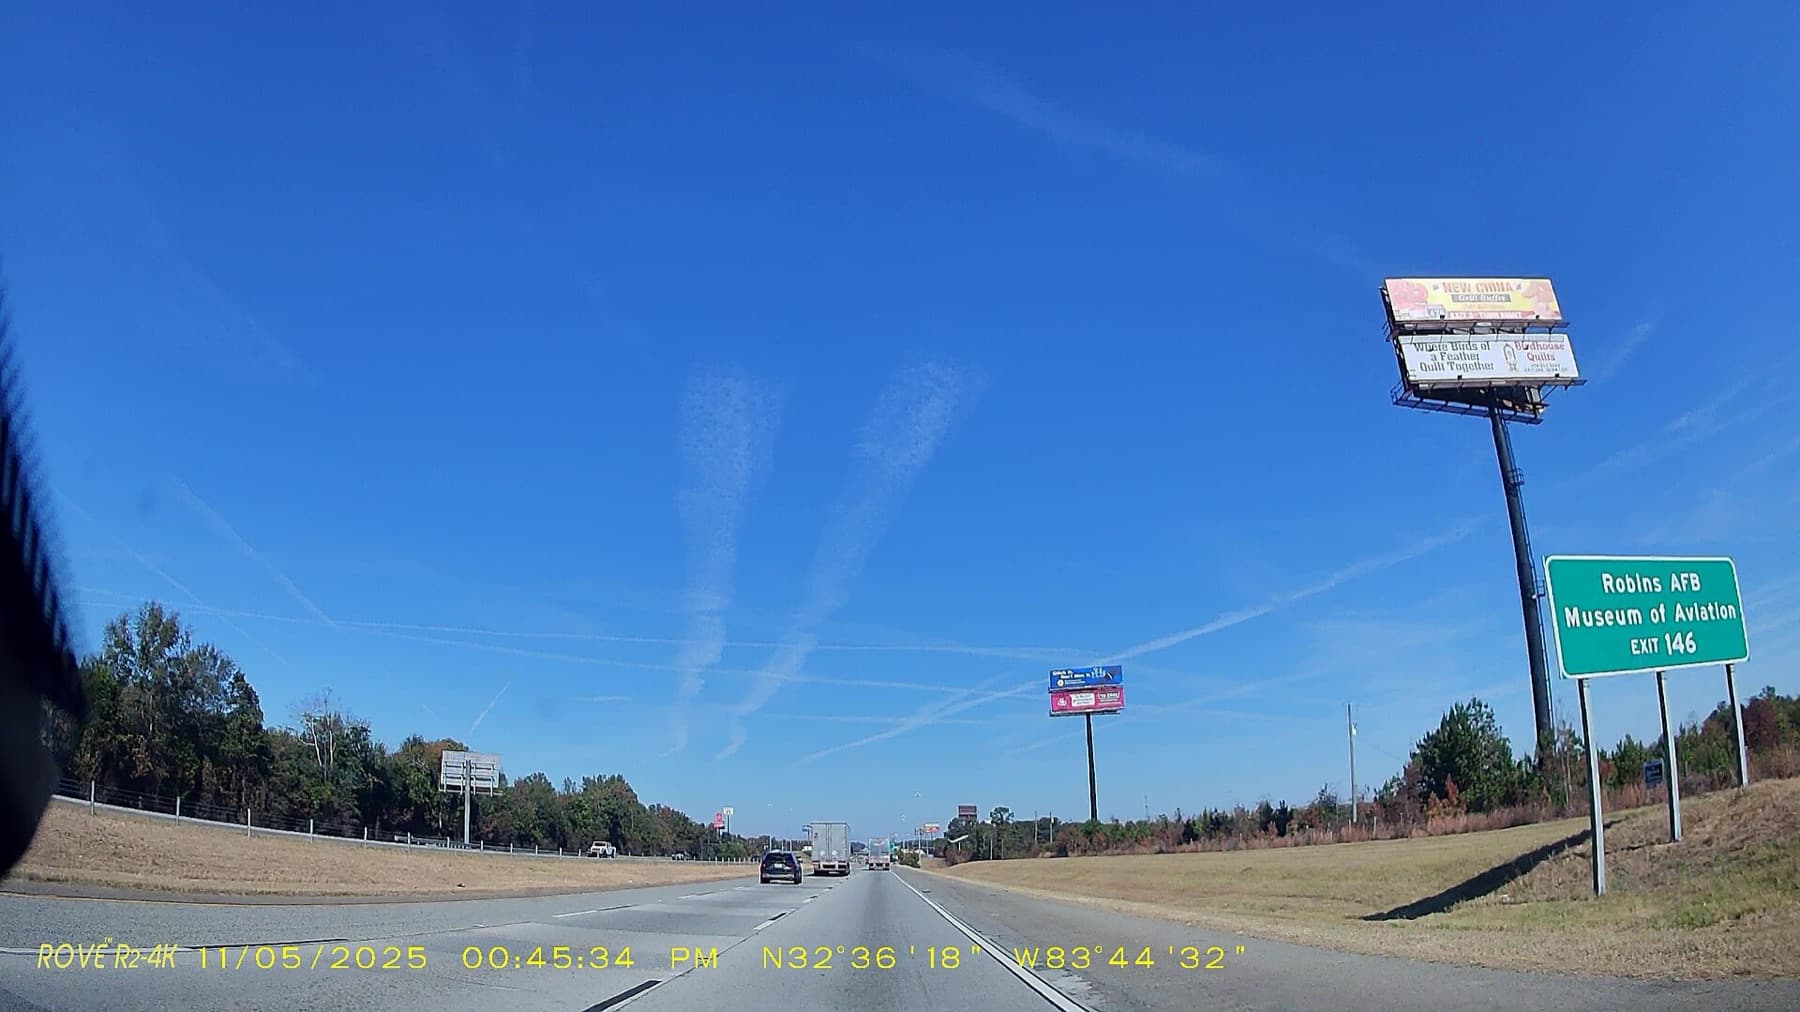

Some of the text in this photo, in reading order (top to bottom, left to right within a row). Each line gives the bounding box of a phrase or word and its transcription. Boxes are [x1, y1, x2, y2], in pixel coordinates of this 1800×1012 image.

[1442, 282, 1512, 293] NEW CHINA
[1450, 343, 1478, 351] Birds
[1481, 342, 1491, 350] of
[1515, 341, 1565, 350] Bdhouse
[1440, 352, 1480, 361] Feather
[1527, 352, 1555, 361] Quilts
[1420, 361, 1494, 372] Quilt Together
[1602, 573, 1701, 593] Robins AFB
[1564, 602, 1736, 628] Museum of Aviation
[1631, 632, 1697, 655] EXIT 146
